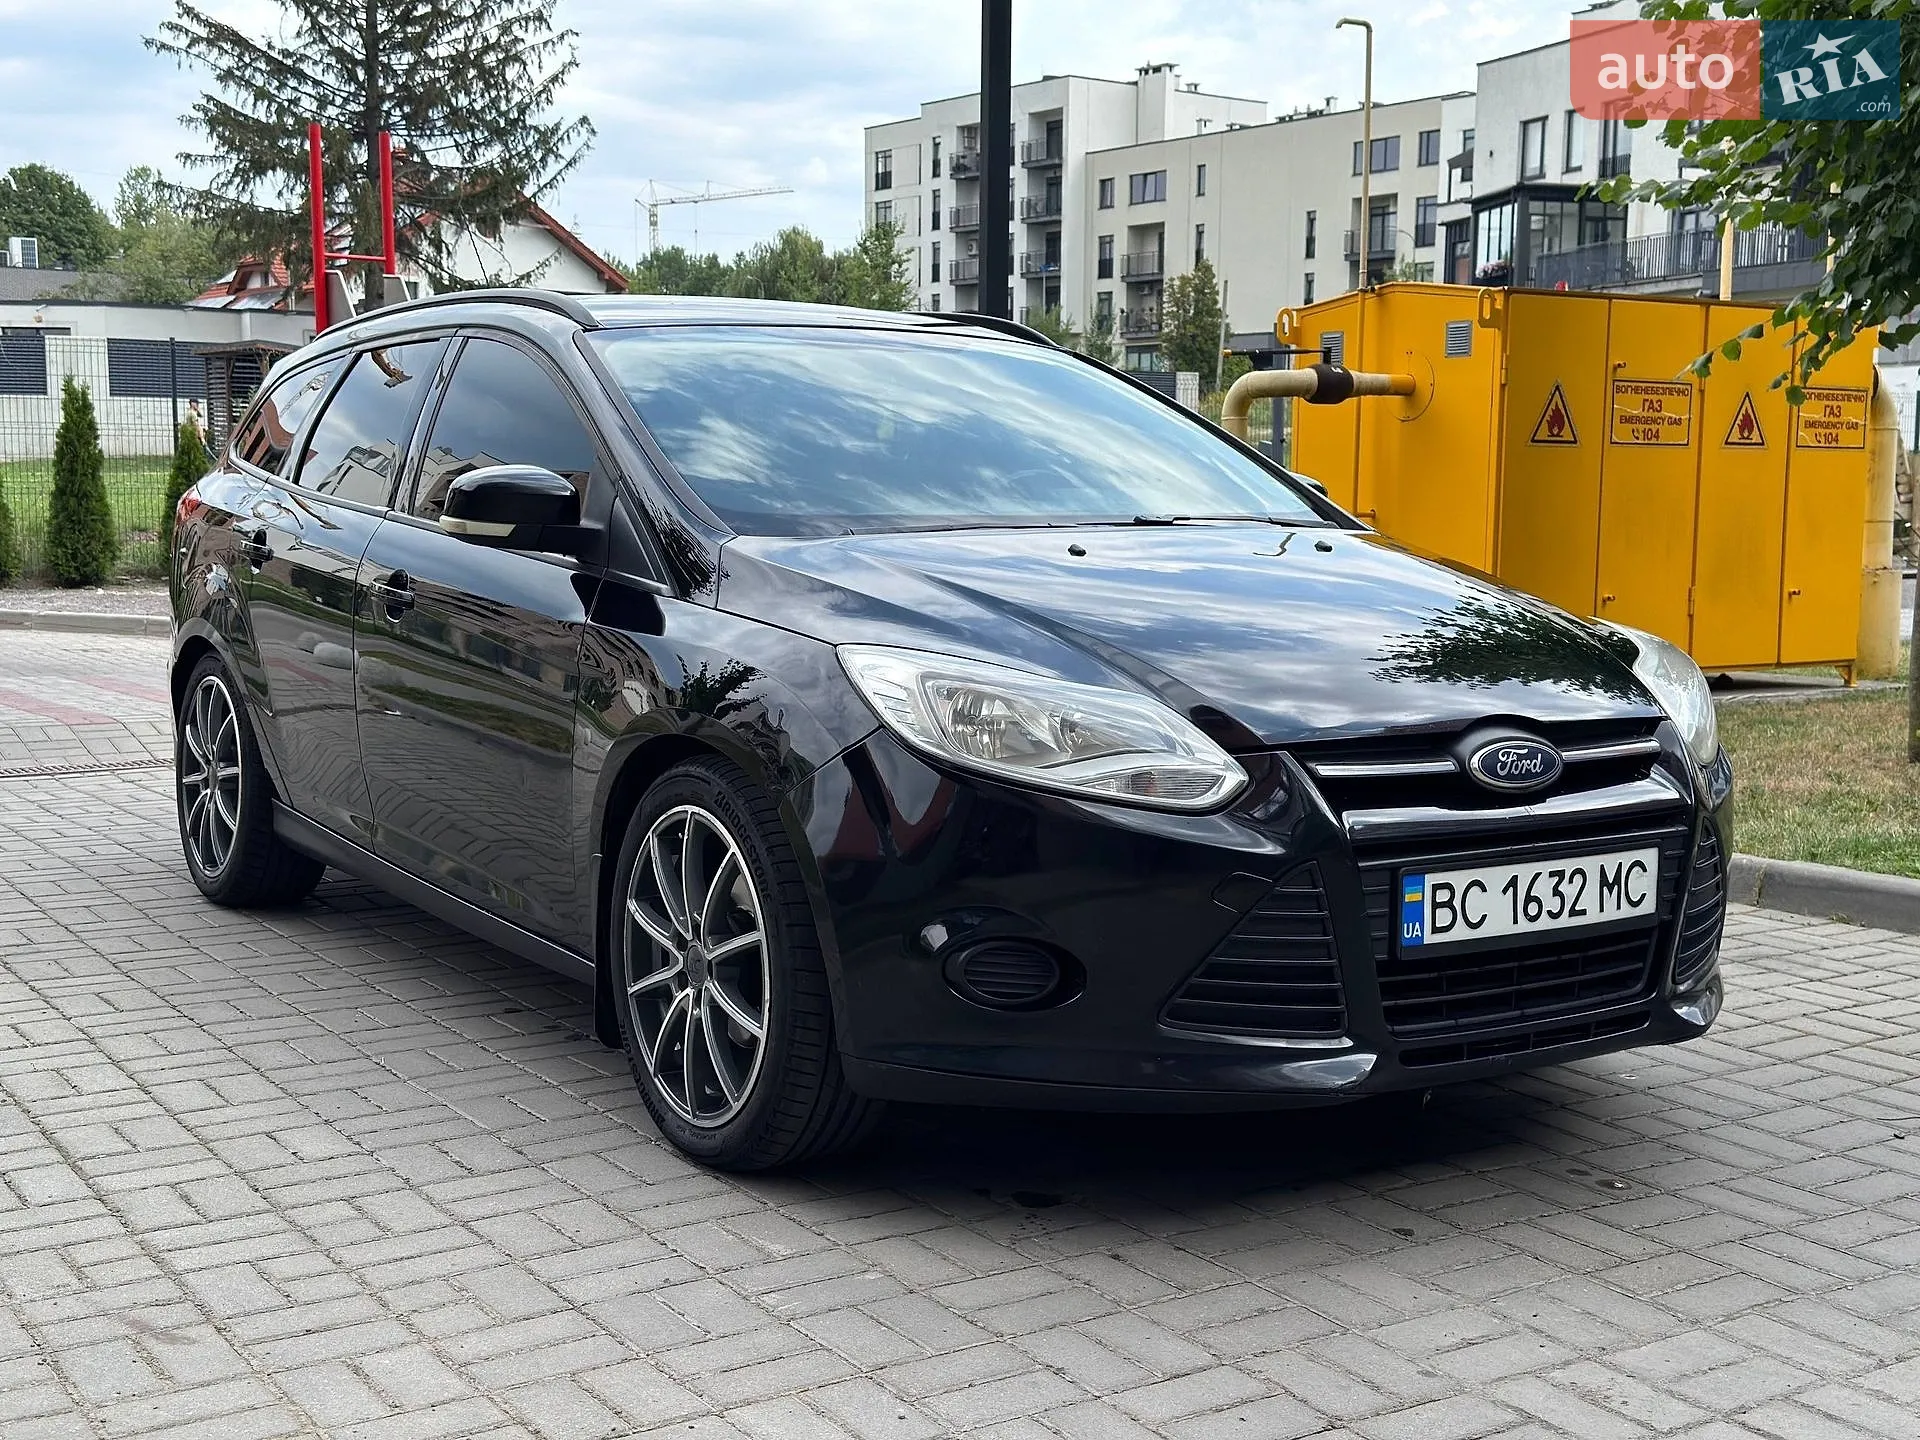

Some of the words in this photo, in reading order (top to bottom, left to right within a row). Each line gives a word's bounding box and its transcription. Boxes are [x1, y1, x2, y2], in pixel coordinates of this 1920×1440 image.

[1615, 384, 1690, 397] ВОГНЕНЕБЕЗПЕЧНО
[1805, 391, 1865, 404] ОГНЕНЕБЕЗПЕЧНО
[1642, 398, 1663, 413] ГАЗ
[1824, 405, 1842, 418] ГАЗ
[1619, 415, 1666, 426] EMERGENCY
[1667, 416, 1683, 426] GAS
[1804, 420, 1845, 430] EMERGENCY
[1846, 421, 1859, 430] GAS
[1642, 427, 1661, 441] 104
[1823, 432, 1839, 445] 104
[1496, 748, 1544, 776] Ford
[712, 790, 773, 903] BRIDGESTONE
[1430, 879, 1488, 935] BC
[1501, 867, 1588, 925] 1632
[1599, 859, 1648, 914] MC
[1403, 922, 1422, 938] UA
